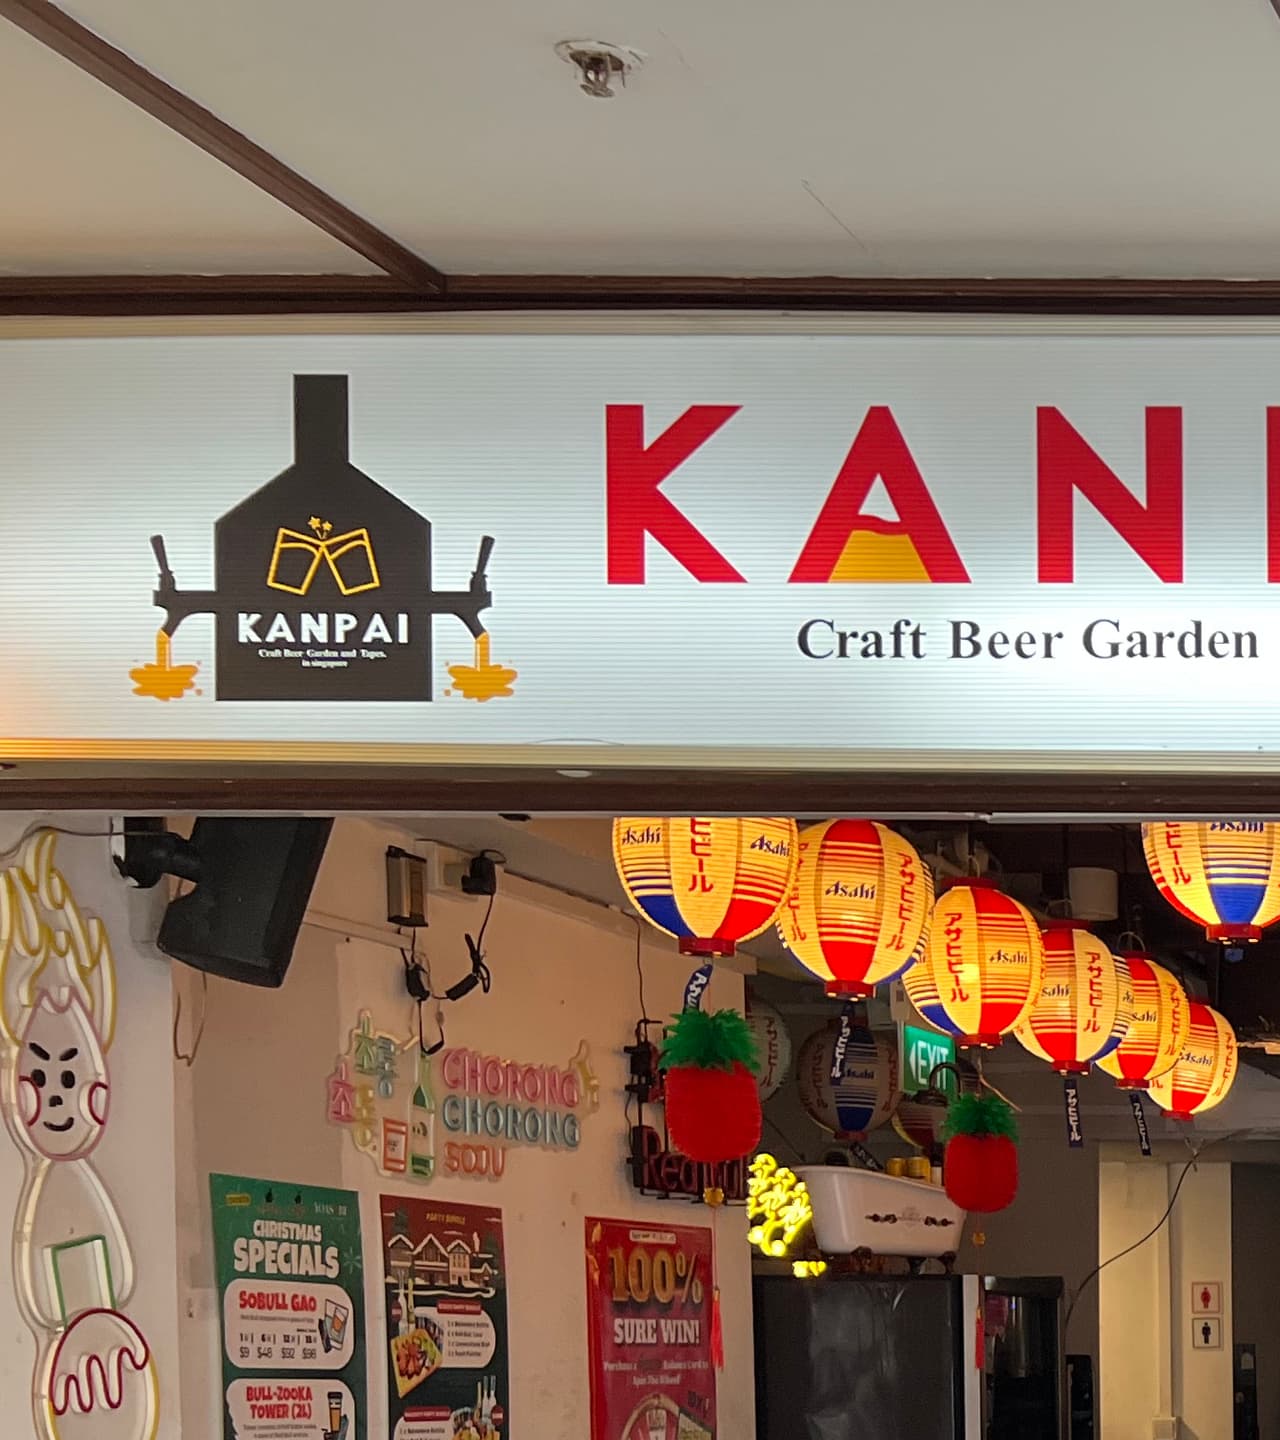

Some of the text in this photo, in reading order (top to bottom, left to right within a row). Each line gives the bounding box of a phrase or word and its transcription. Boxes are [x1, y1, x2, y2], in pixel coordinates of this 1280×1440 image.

[237, 612, 409, 644] KANPAI
[797, 619, 927, 662] Craft
[947, 620, 1064, 662] Beer
[1082, 618, 1260, 662] Garden
[622, 826, 661, 846] Asahi
[750, 834, 791, 857] Asahi
[825, 881, 876, 900] Asahi
[886, 852, 916, 951] アサヒビール
[945, 912, 969, 1003] アサヒビール
[989, 949, 1028, 964] Asahi
[1041, 983, 1070, 998] sahi
[1084, 951, 1103, 1033] アサヒビール
[1132, 1010, 1157, 1024] sahi
[443, 1048, 578, 1108] CHORONG
[917, 1040, 949, 1089] EXIT
[443, 1094, 580, 1148] CHORONG
[445, 1142, 505, 1177] SOJU
[253, 1219, 322, 1242] CHRISTMAS
[233, 1237, 340, 1279] SPECIALS
[607, 1246, 704, 1304] 100%
[291, 1294, 317, 1312] GAO
[614, 1317, 700, 1345] SURE WIN!
[250, 1404, 289, 1419] TOWER
